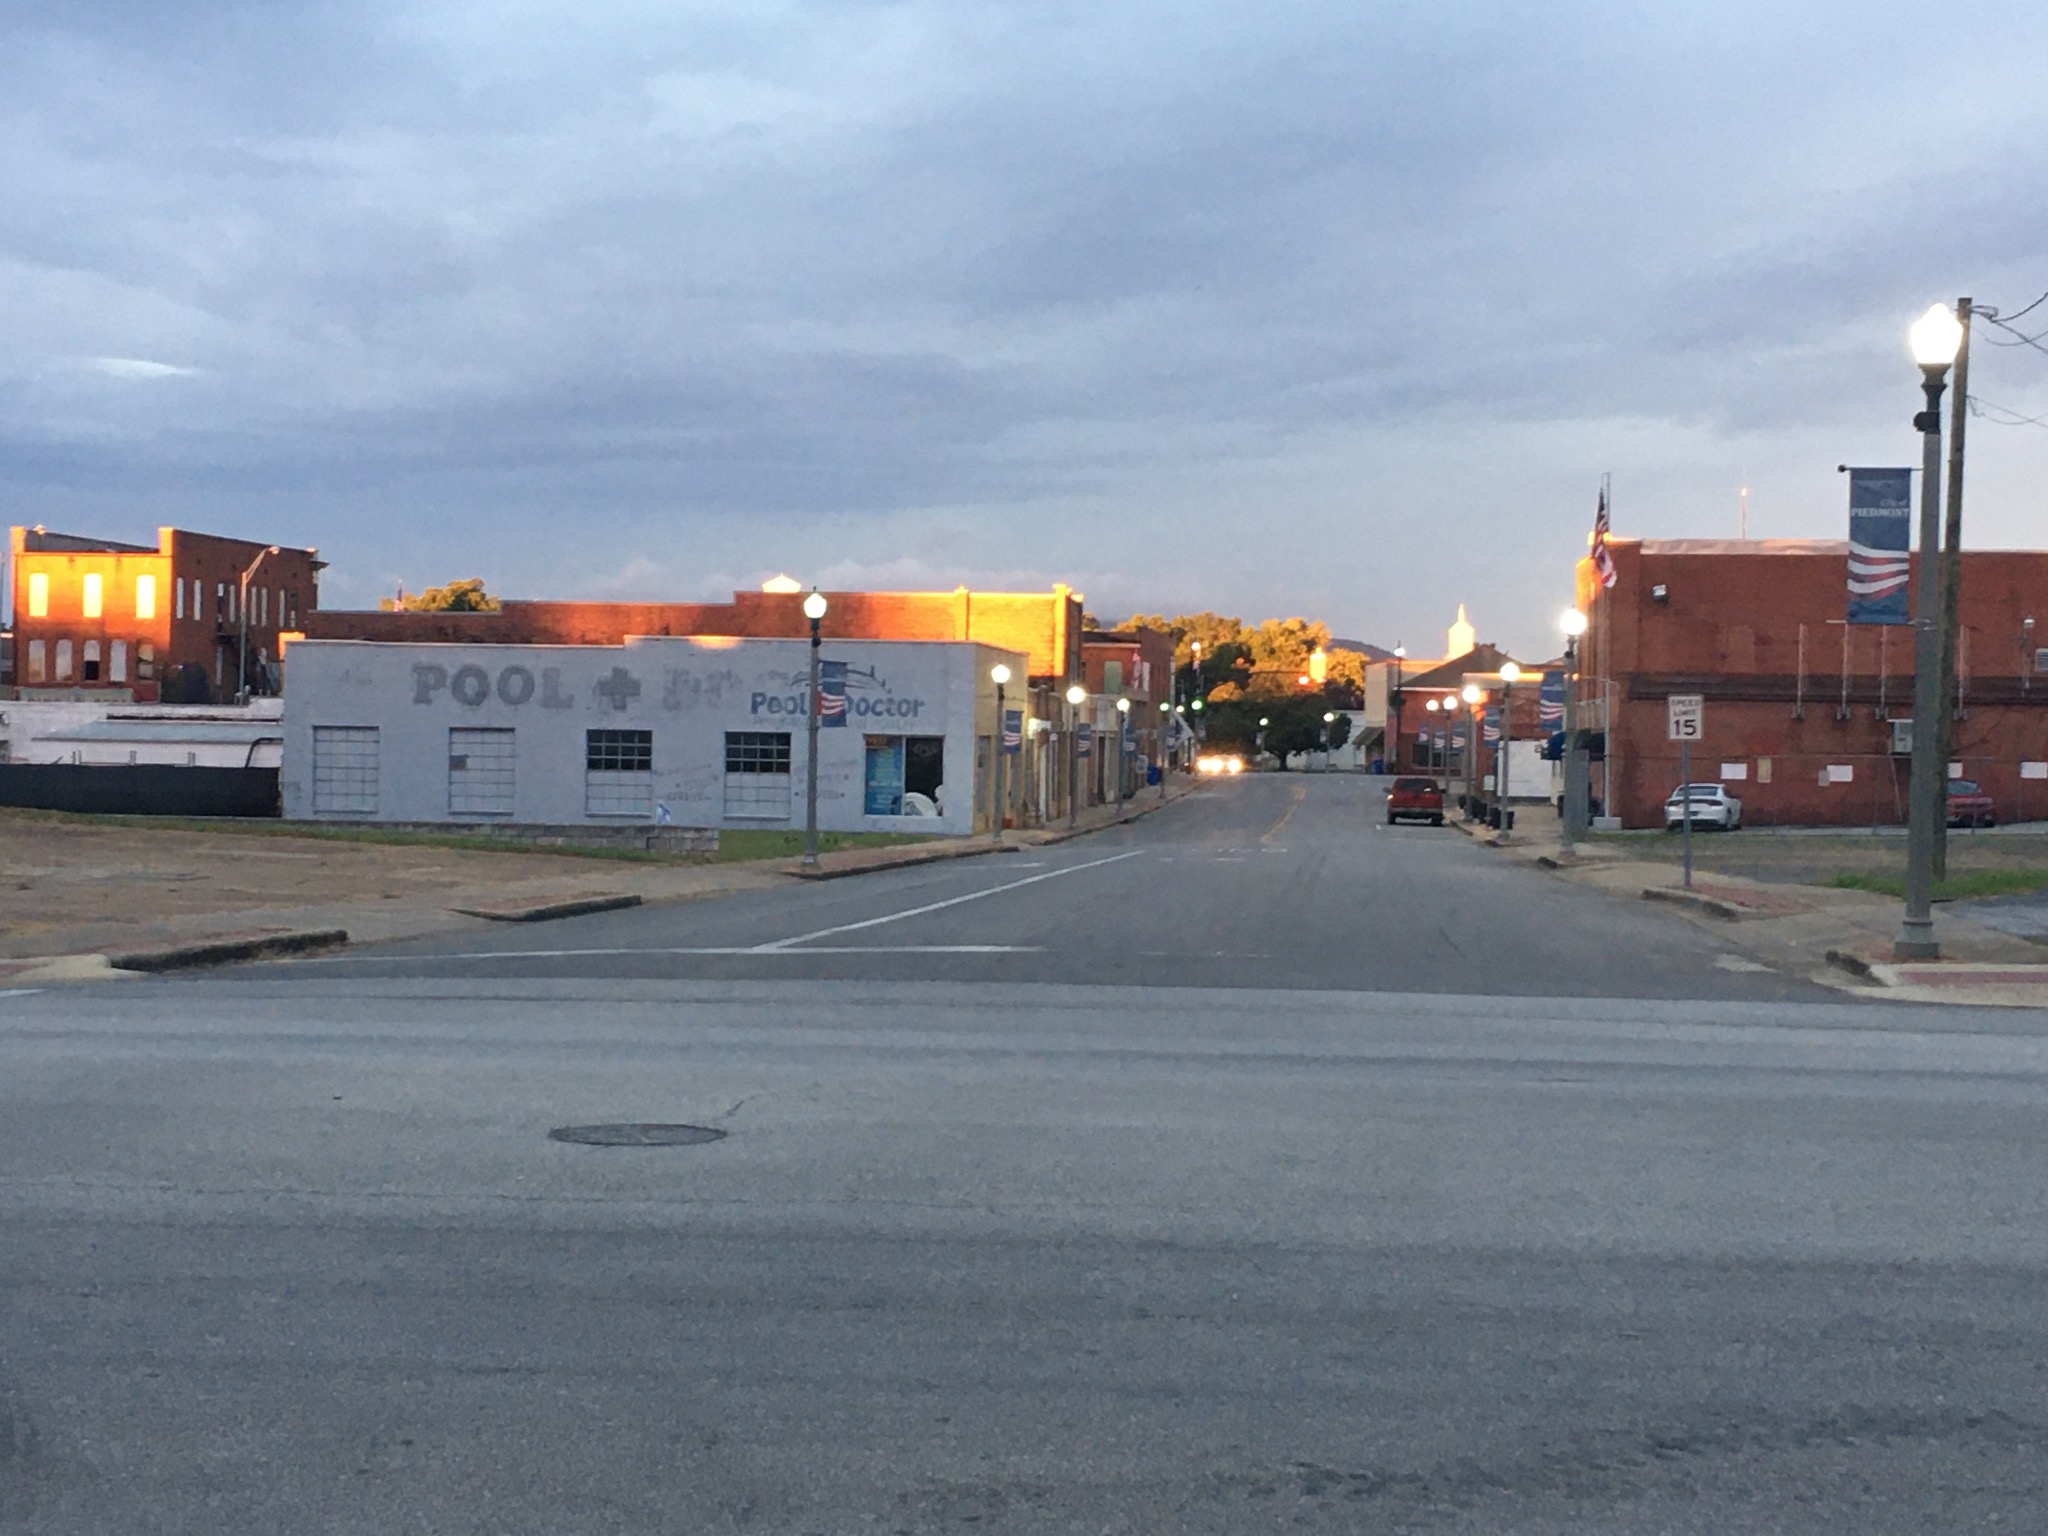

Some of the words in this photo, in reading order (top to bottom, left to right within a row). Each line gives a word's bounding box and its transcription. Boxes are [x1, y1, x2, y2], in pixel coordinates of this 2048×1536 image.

[1851, 507, 1910, 518] PIEDMONT
[411, 662, 574, 709] POOL
[750, 691, 808, 716] Pool
[1673, 719, 1697, 736] 15
